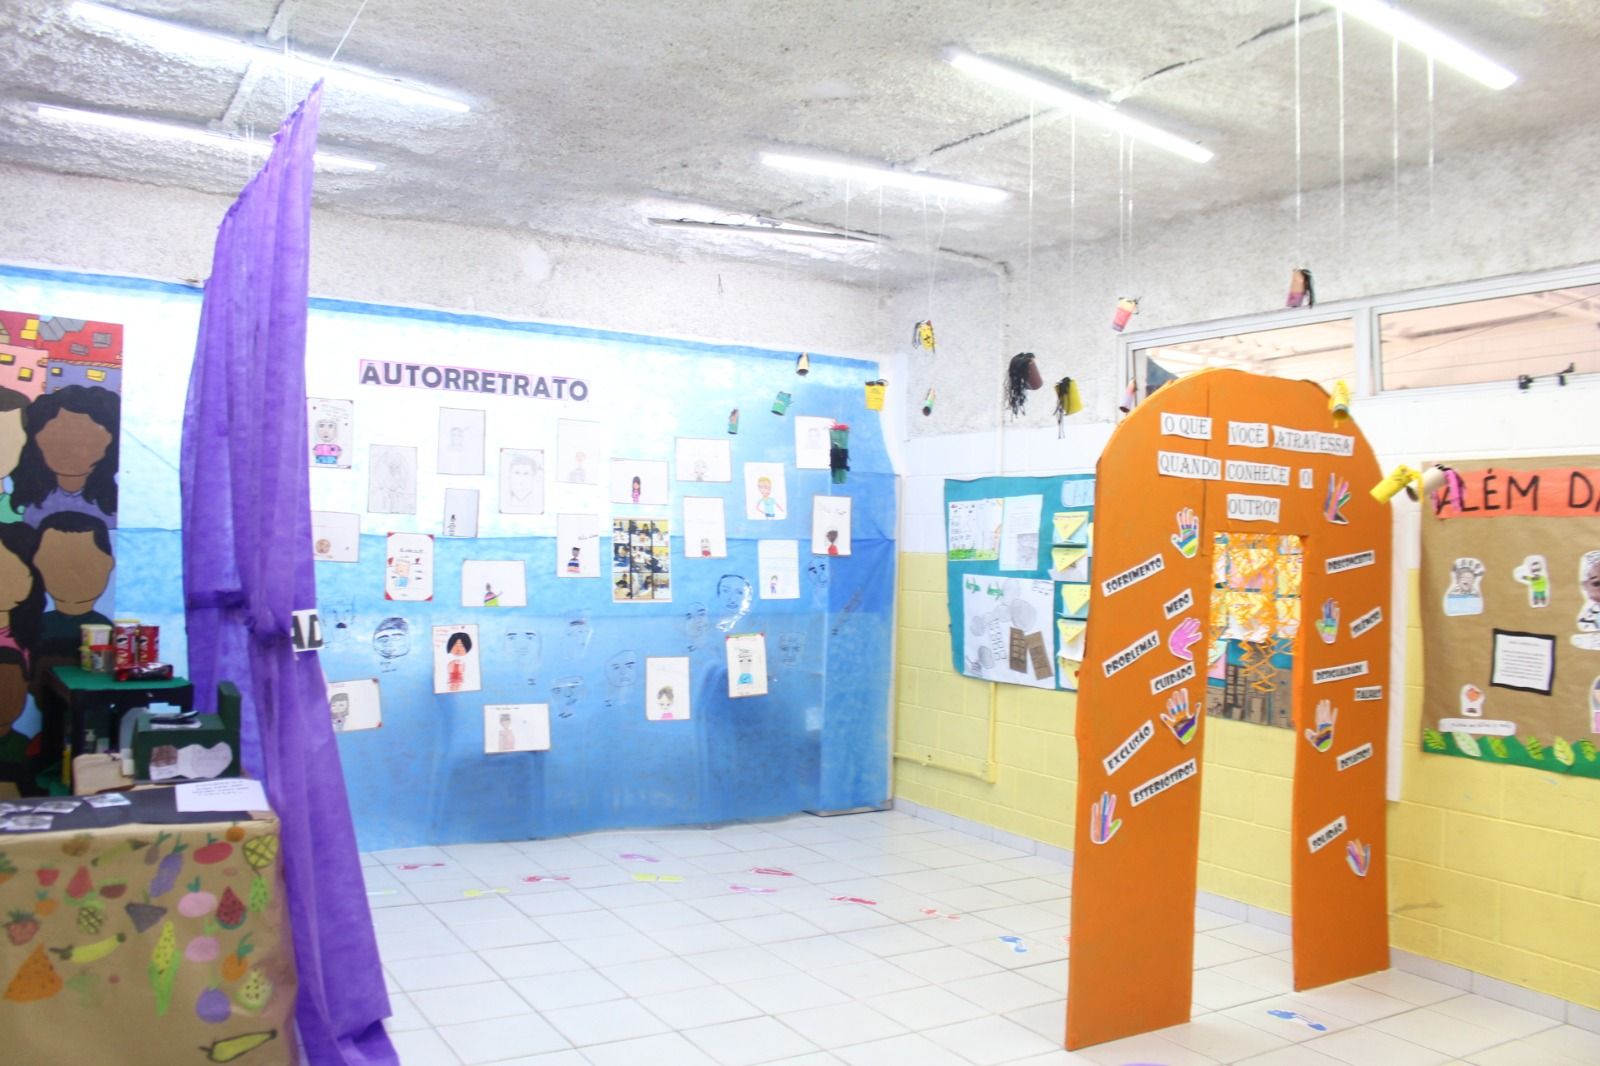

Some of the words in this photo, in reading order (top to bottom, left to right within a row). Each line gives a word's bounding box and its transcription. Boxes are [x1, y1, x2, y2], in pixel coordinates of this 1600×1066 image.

[361, 362, 589, 401] AUTORRETRATO
[1164, 416, 1175, 433] O
[1179, 418, 1208, 435] QUE
[1230, 423, 1265, 444] VOCÊ
[1275, 431, 1352, 454] ATRAVESSA
[1159, 455, 1220, 477] QUANDO
[1226, 463, 1288, 483] CONHECE
[1301, 470, 1312, 486] O
[1228, 498, 1278, 516] OUTRO?
[1105, 557, 1163, 593] SOFRIMENTO
[1165, 593, 1190, 616] MEDO
[1105, 635, 1158, 675] PROBLEMAS
[1154, 665, 1193, 691] CUIDADO
